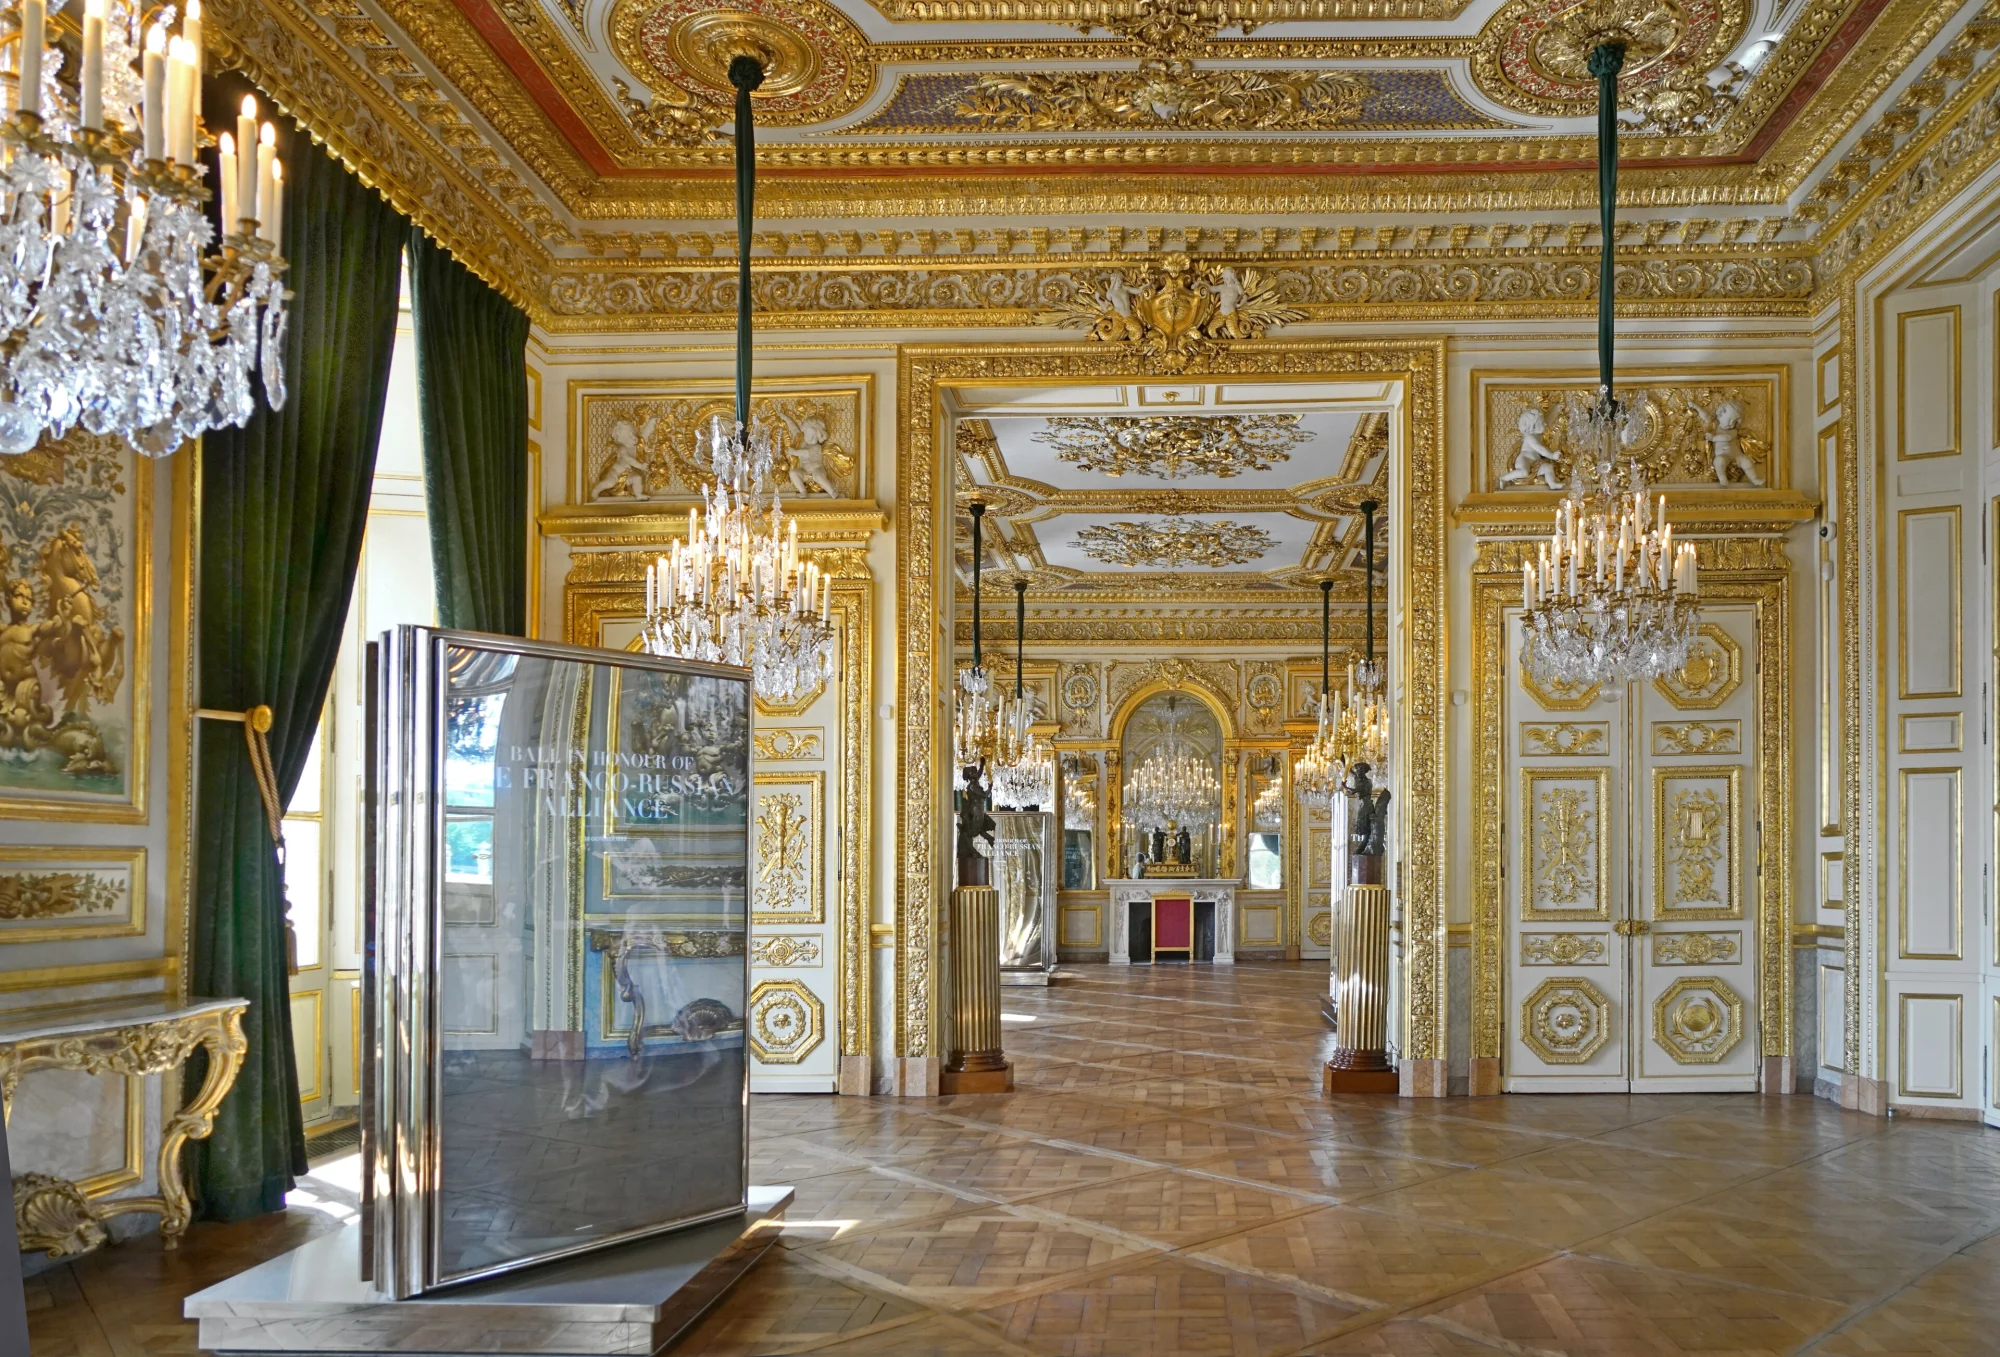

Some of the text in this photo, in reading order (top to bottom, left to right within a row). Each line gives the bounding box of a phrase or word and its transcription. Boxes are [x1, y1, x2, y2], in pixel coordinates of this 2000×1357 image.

[510, 745, 695, 771] BALL IN HONOUR OF
[522, 767, 735, 796] FRANCO-RUSSIAN
[540, 795, 668, 819] ALLIANCE
